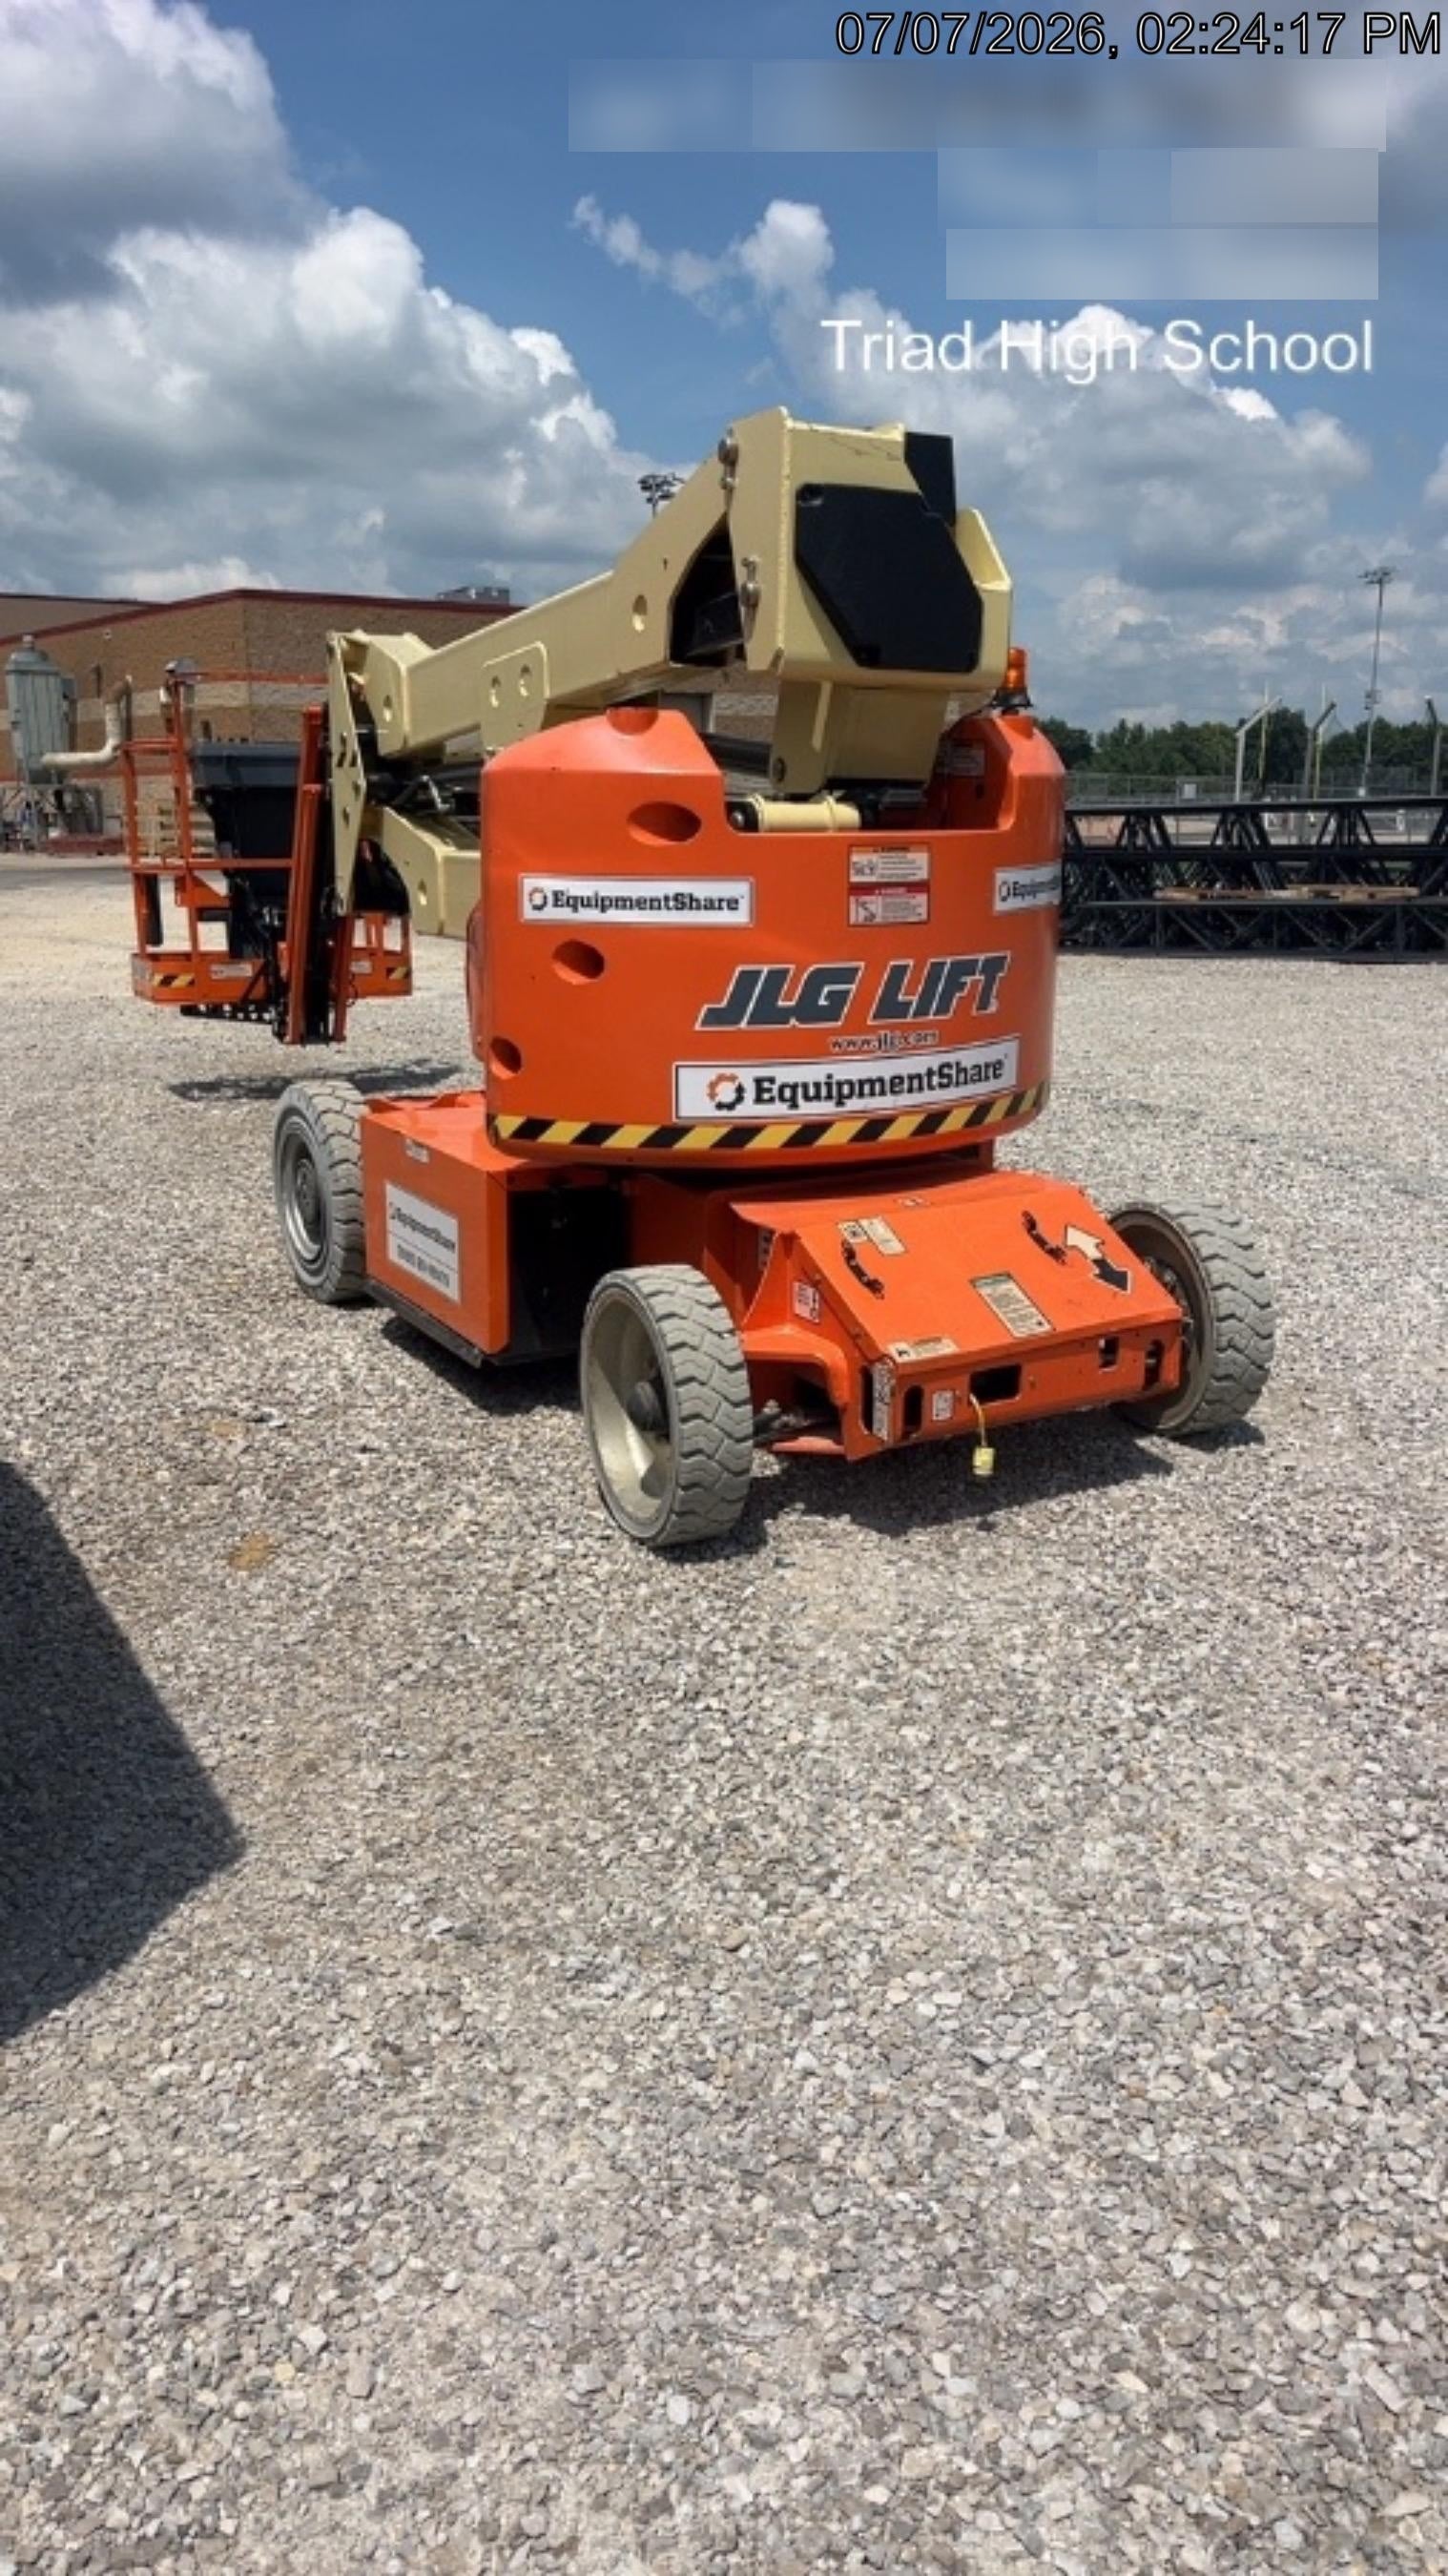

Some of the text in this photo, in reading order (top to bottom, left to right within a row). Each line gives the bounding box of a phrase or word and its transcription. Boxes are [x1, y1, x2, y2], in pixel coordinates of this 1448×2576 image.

[551, 889, 741, 913] EquipmentShare
[694, 950, 1011, 1031] JLG LIFT
[752, 1060, 1005, 1109] EquipmentShare
